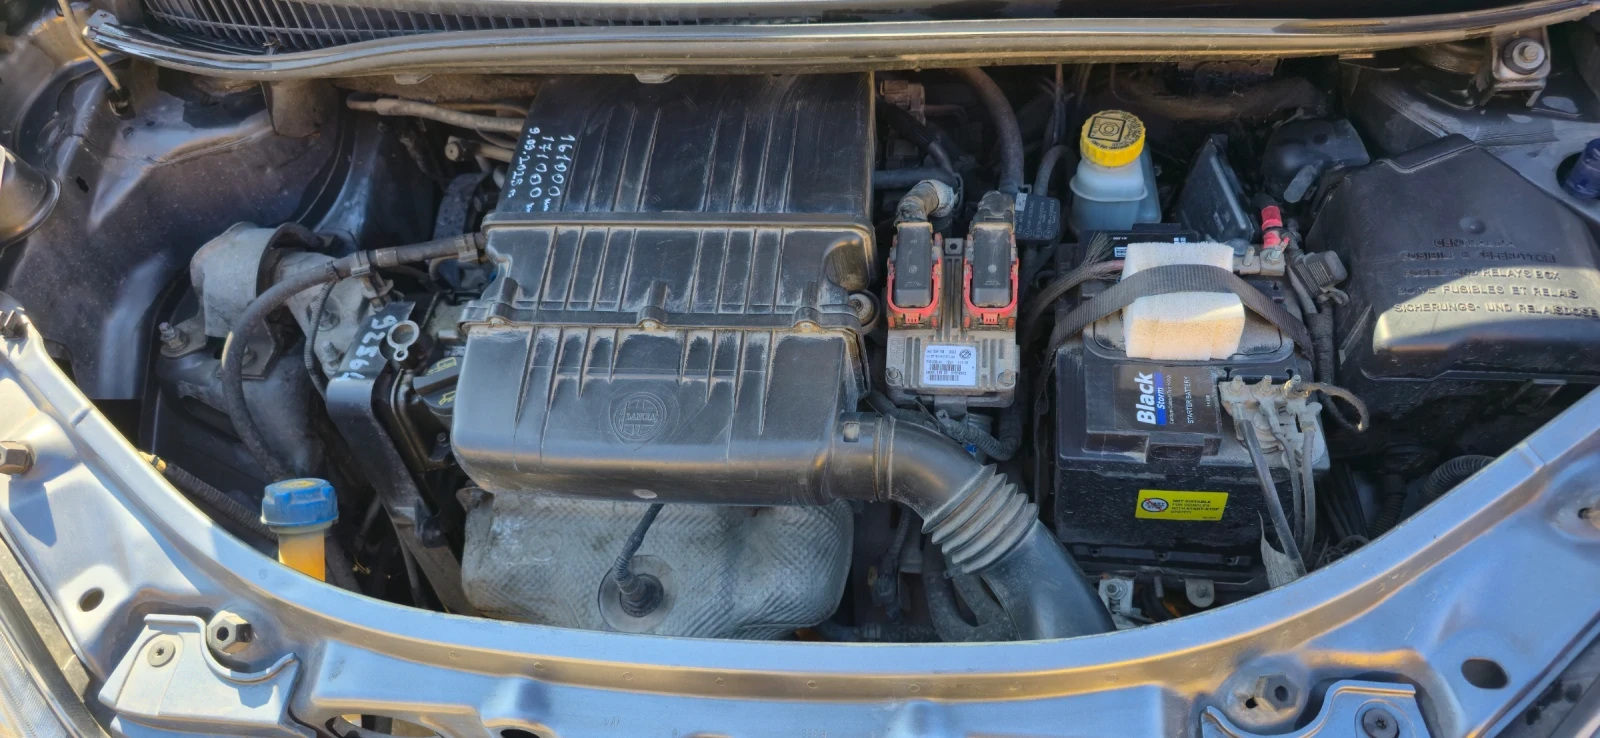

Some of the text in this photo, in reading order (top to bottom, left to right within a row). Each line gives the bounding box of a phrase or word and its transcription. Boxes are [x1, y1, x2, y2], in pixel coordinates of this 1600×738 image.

[530, 136, 555, 198] 171000
[548, 134, 576, 197] 161000
[1481, 268, 1533, 279] RELAYS
[1535, 269, 1561, 281] BOX
[1442, 285, 1505, 296] FUSIBLES
[1511, 286, 1527, 297] ET
[1533, 287, 1580, 300] RELAIS
[1393, 302, 1481, 314] SICHERUNGS-
[1486, 302, 1513, 314] UND
[1133, 371, 1157, 426] Black
[1156, 386, 1166, 410] Storm
[1183, 375, 1195, 425] STARTER BATTERY
[625, 412, 657, 421] LANCIA
